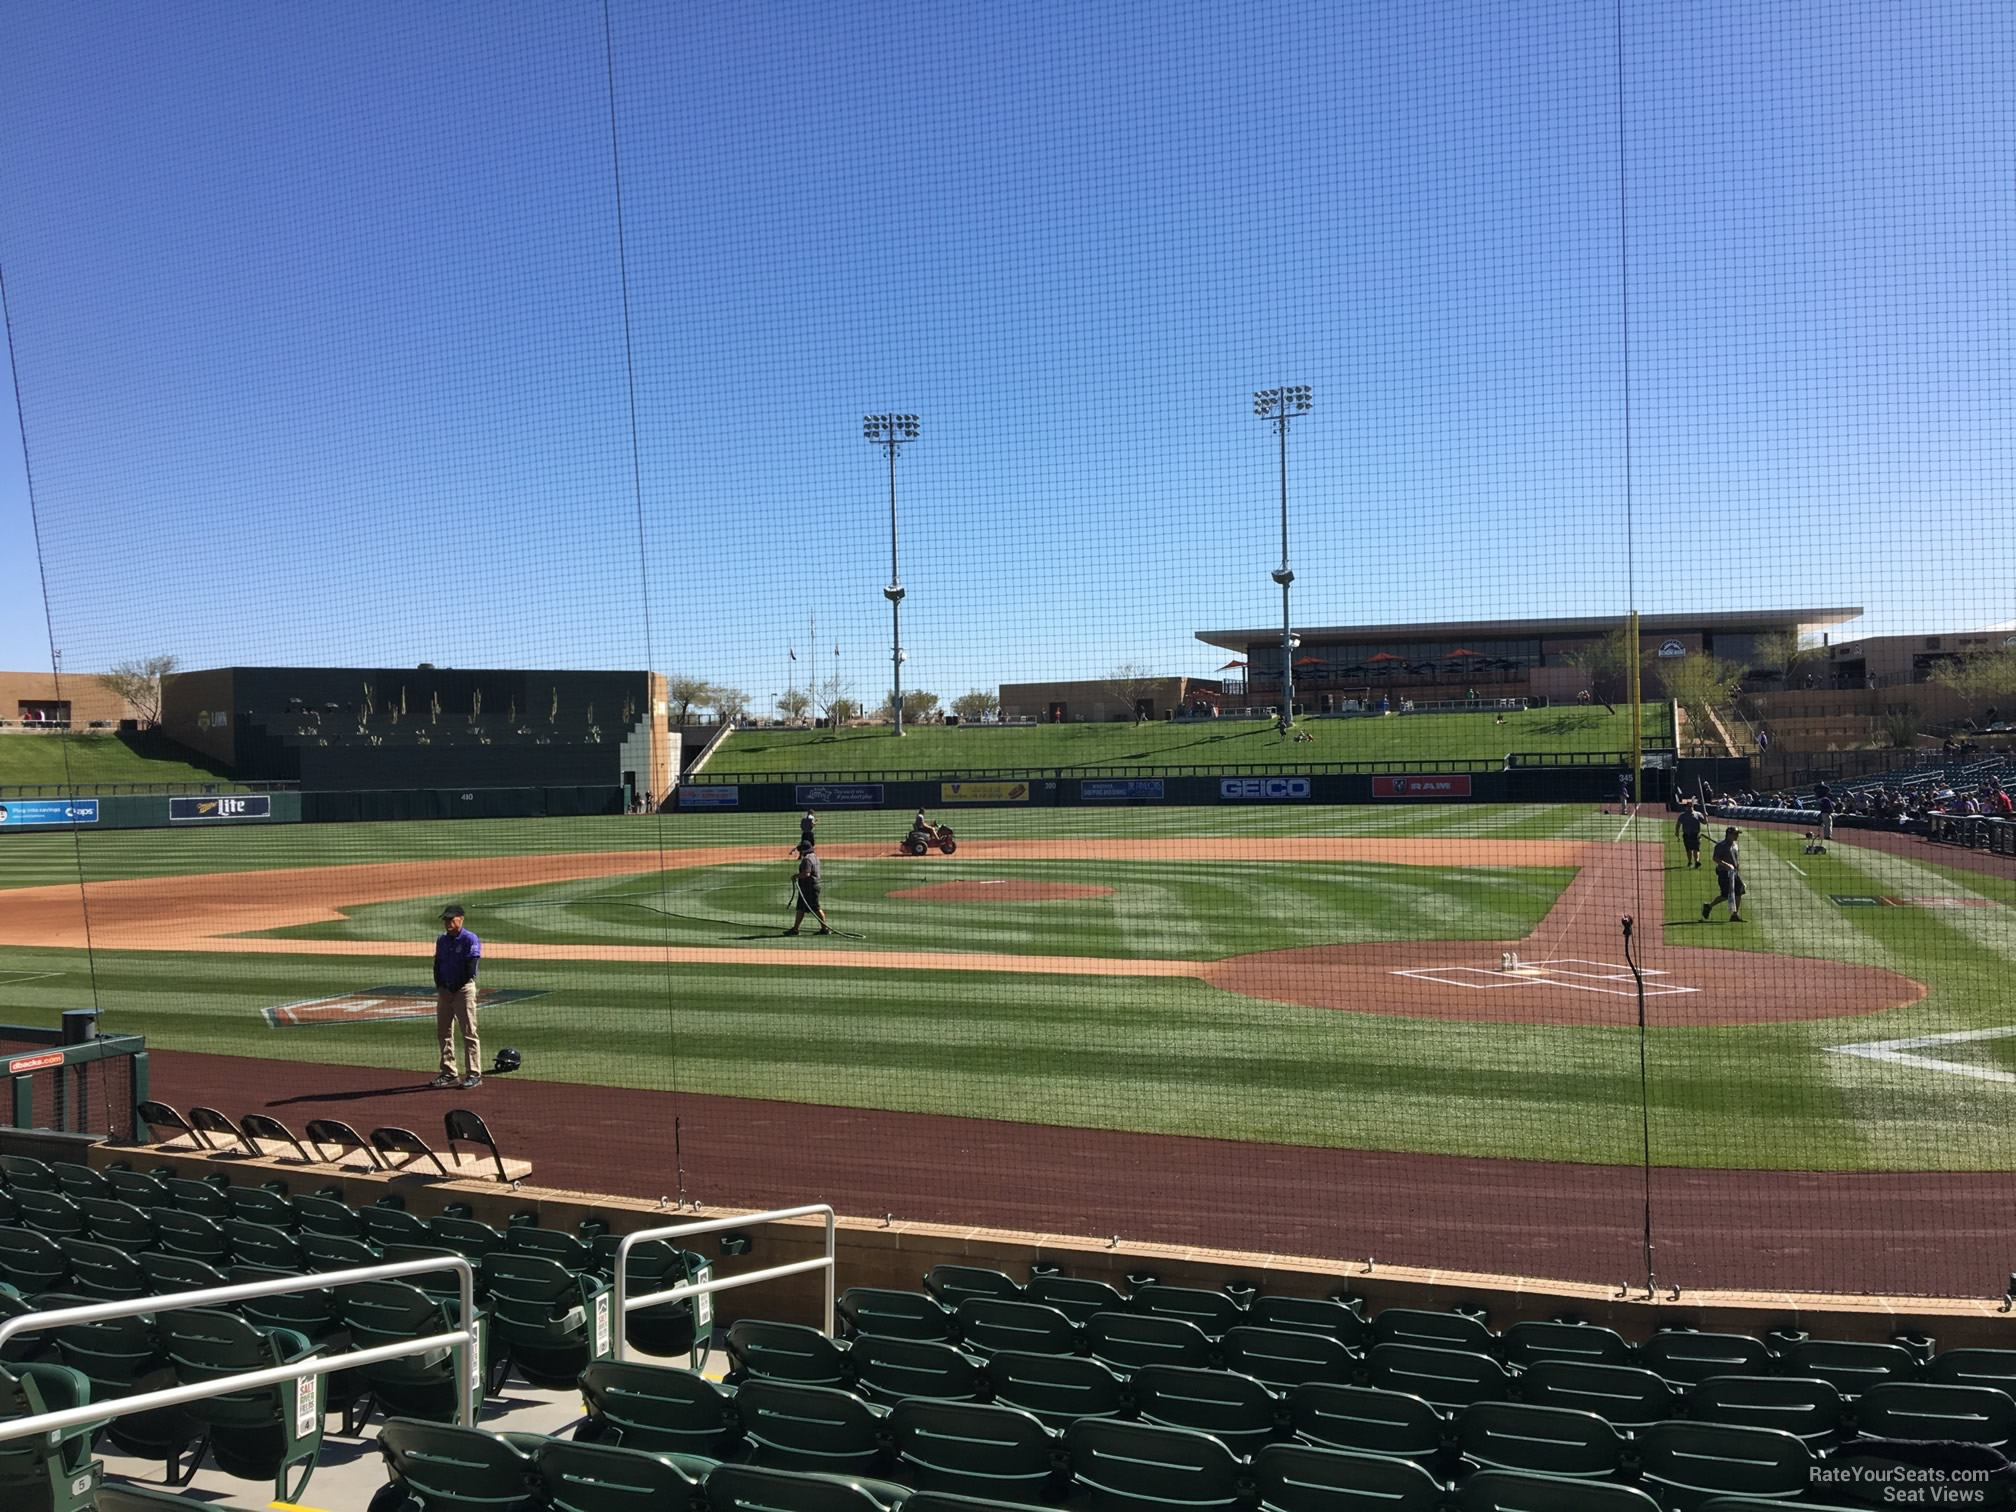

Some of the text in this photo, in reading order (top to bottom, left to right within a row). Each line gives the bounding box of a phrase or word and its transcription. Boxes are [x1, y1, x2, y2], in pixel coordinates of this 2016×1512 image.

[1619, 774, 1633, 782] 345
[1221, 779, 1309, 797] GEICO
[1410, 782, 1451, 790] RAM
[461, 793, 473, 801] 410
[76, 807, 94, 817] aps
[217, 799, 245, 816] Lite
[300, 1380, 315, 1395] SALT
[300, 1391, 315, 1405] RIVER
[304, 1420, 310, 1429] 4
[78, 1478, 85, 1490] 5
